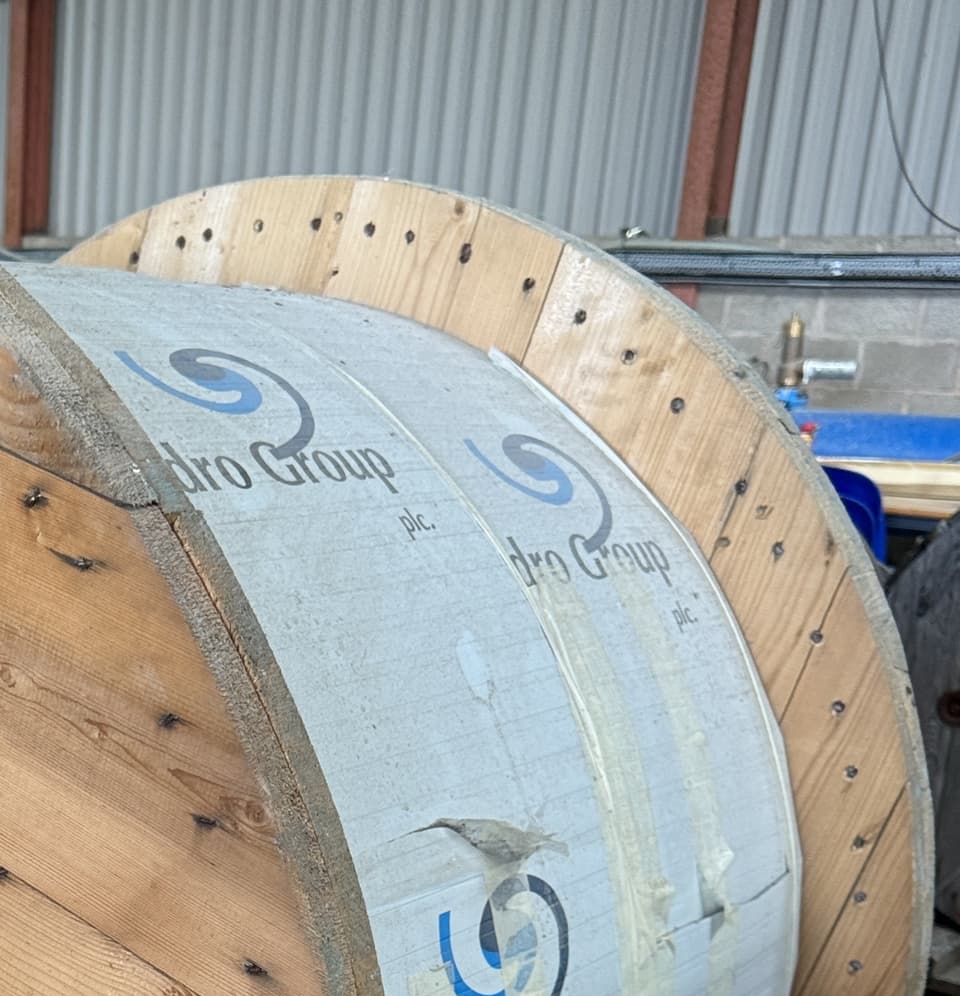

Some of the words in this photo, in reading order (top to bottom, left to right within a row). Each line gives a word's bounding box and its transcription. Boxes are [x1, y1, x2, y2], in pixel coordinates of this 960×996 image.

[249, 441, 399, 494] Group
[398, 507, 436, 541] plc.
[569, 534, 673, 588] Group
[671, 602, 699, 633] plc.
